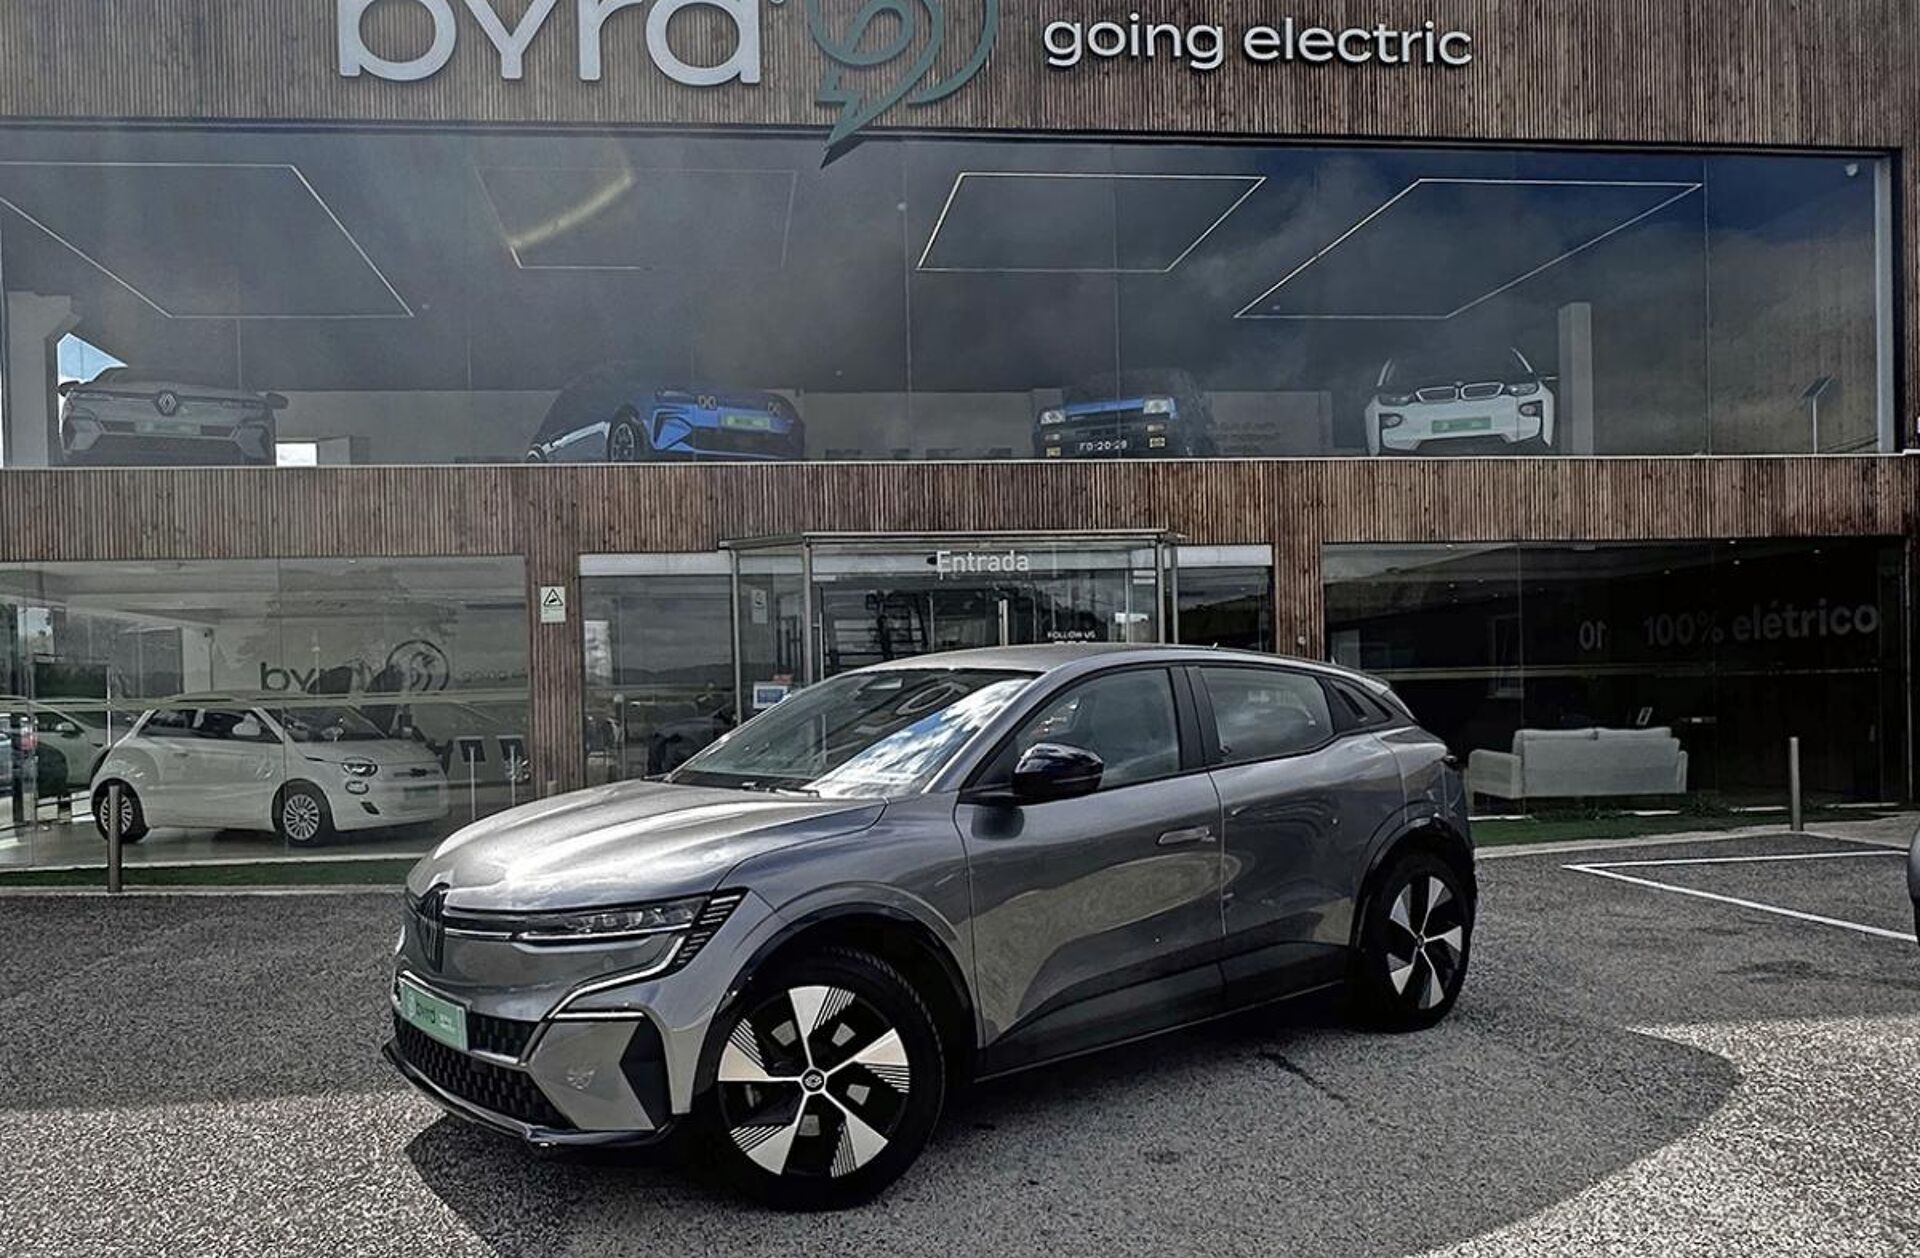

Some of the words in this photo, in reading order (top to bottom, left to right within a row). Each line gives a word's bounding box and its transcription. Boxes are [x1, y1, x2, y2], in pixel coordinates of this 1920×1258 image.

[1043, 13, 1225, 70] going
[1243, 17, 1473, 65] electric
[936, 550, 1030, 573] Entrada
[1047, 630, 1082, 639] FOLLOW
[1084, 629, 1096, 639] US
[1642, 611, 1725, 646] 100%
[1731, 598, 1879, 641] elétrico
